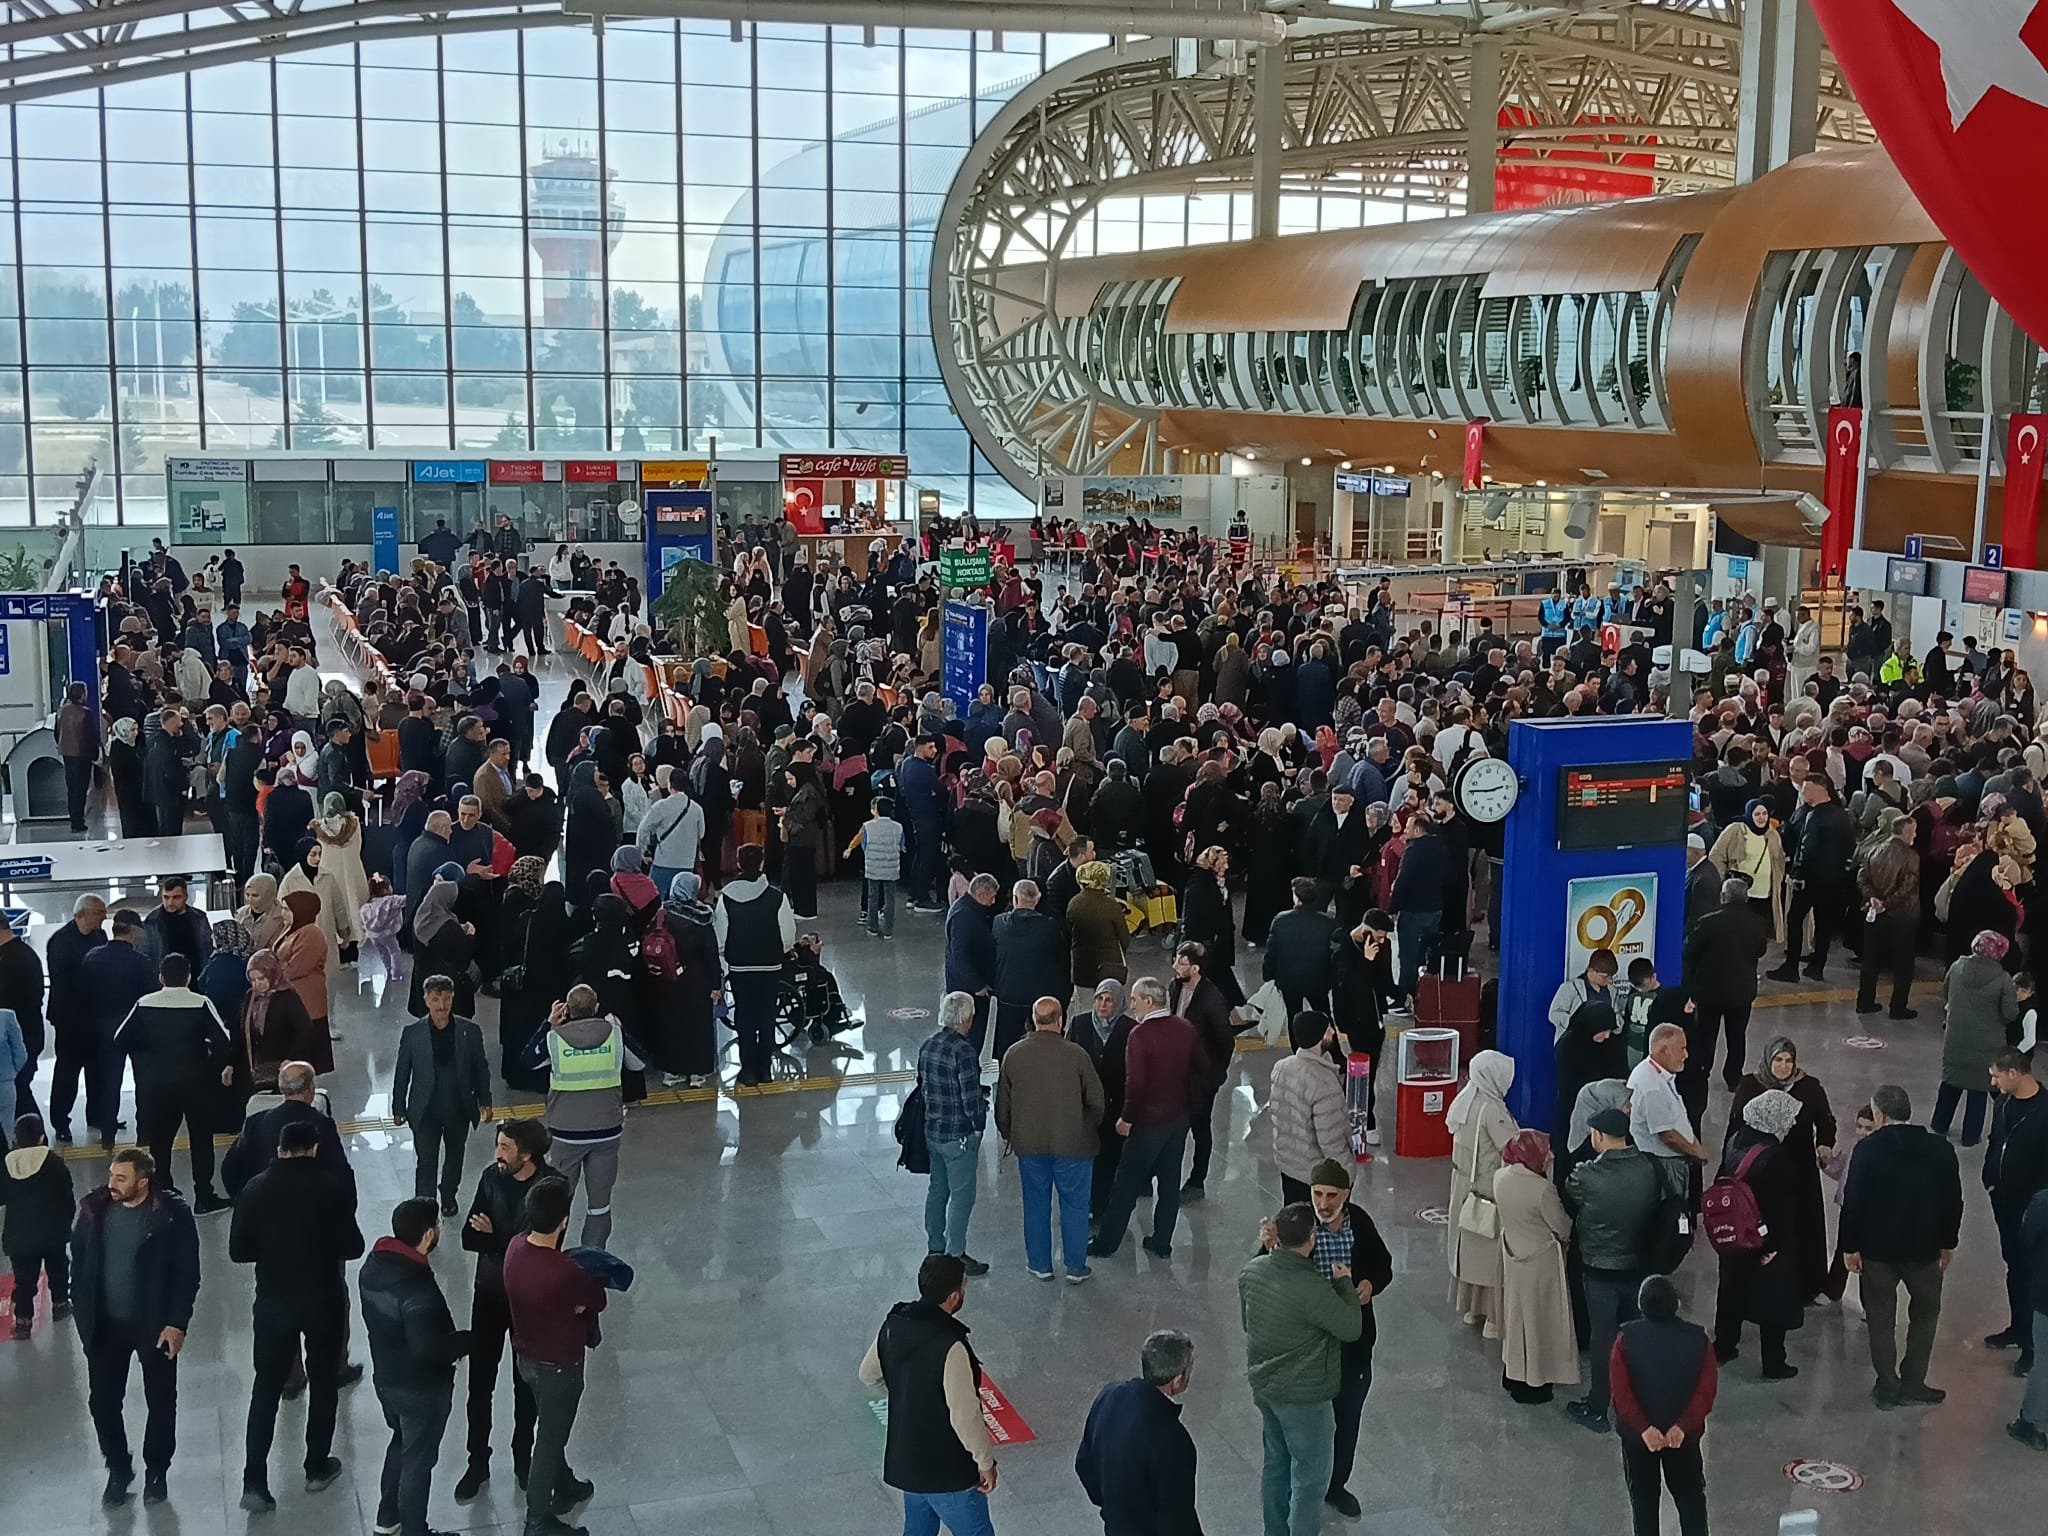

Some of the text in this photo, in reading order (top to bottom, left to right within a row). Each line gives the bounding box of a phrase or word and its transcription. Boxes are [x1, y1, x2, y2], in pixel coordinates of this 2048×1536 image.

[420, 465, 455, 478] AJet
[815, 457, 841, 476] cafe
[850, 457, 877, 476] büfe
[1910, 540, 1916, 555] 1
[954, 556, 987, 567] BULUŞMA
[1988, 548, 1997, 564] 2
[957, 567, 985, 577] NOKTASI
